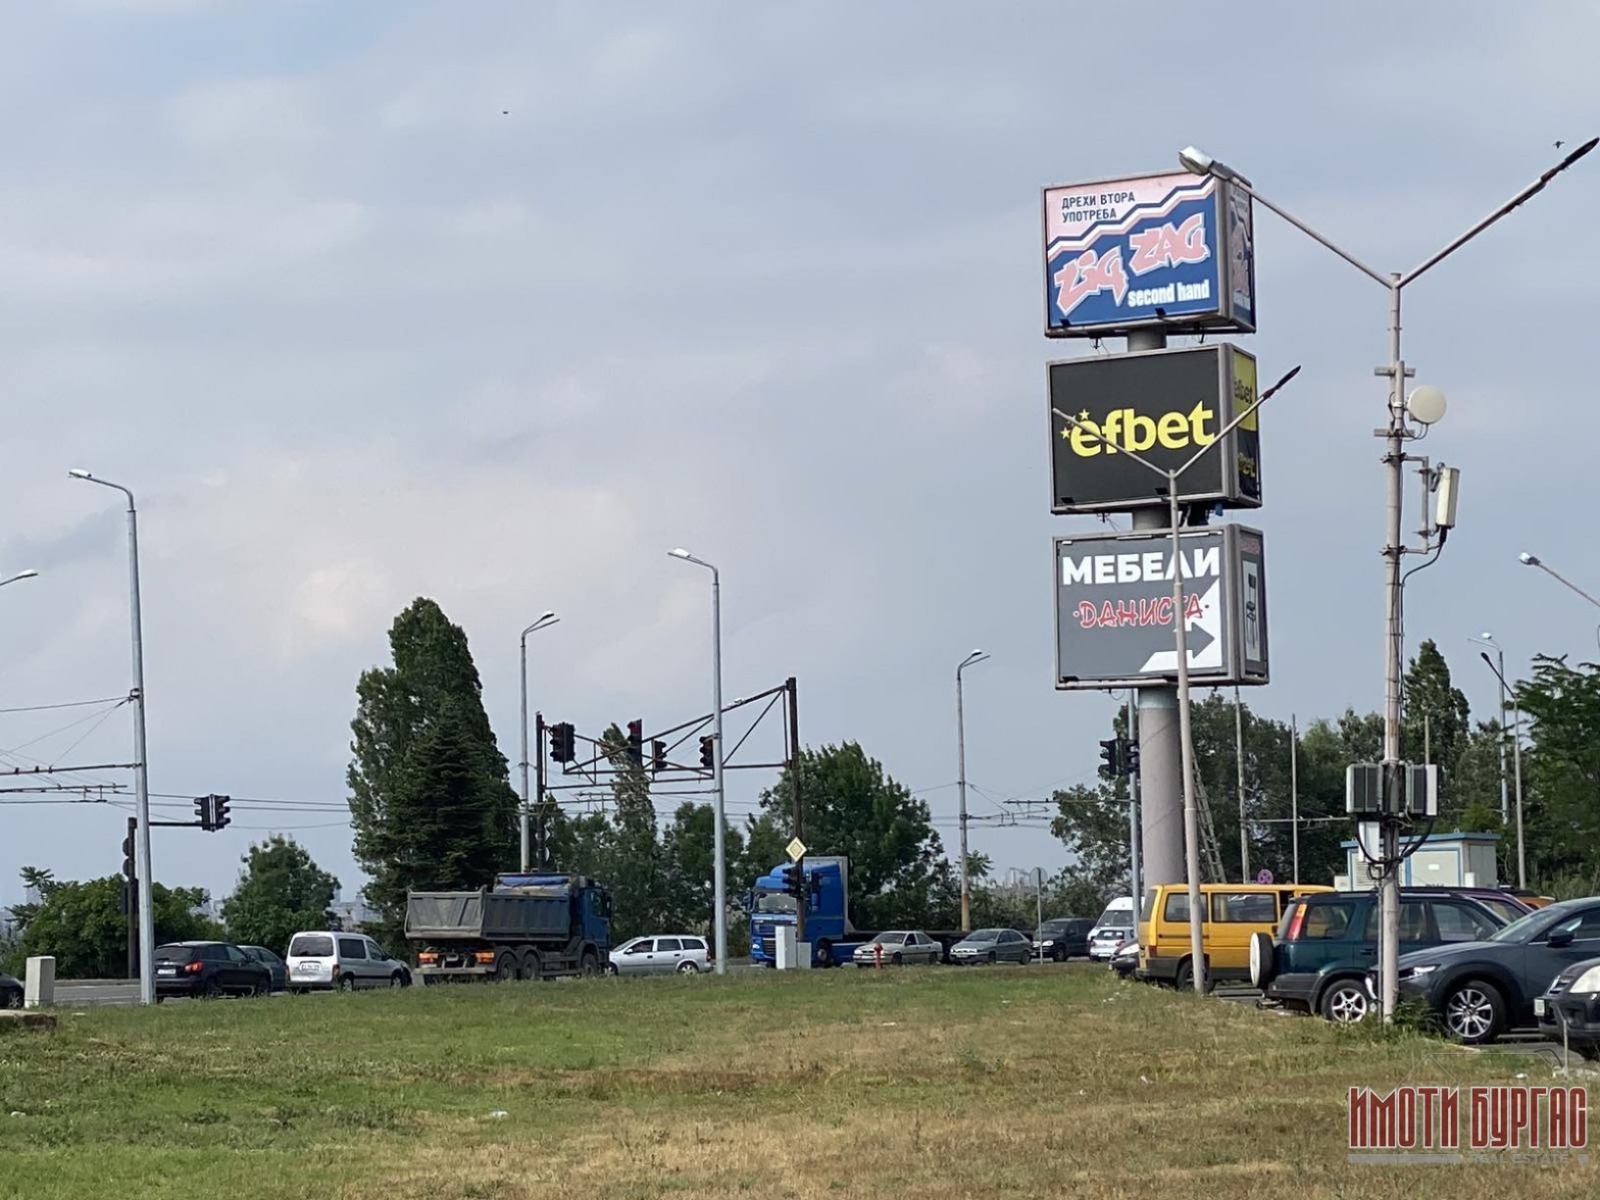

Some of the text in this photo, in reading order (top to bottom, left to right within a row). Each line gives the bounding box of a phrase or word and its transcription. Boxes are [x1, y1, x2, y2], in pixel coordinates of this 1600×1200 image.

[1062, 192, 1136, 209] ДРЕХИ ВТОРА
[1062, 209, 1117, 223] УПОТРЕБА
[1129, 213, 1210, 276] ZAG
[1127, 284, 1175, 307] second
[1178, 279, 1210, 301] hand
[1070, 401, 1216, 458] efbet
[1062, 547, 1220, 585] МЕБЕЛИ
